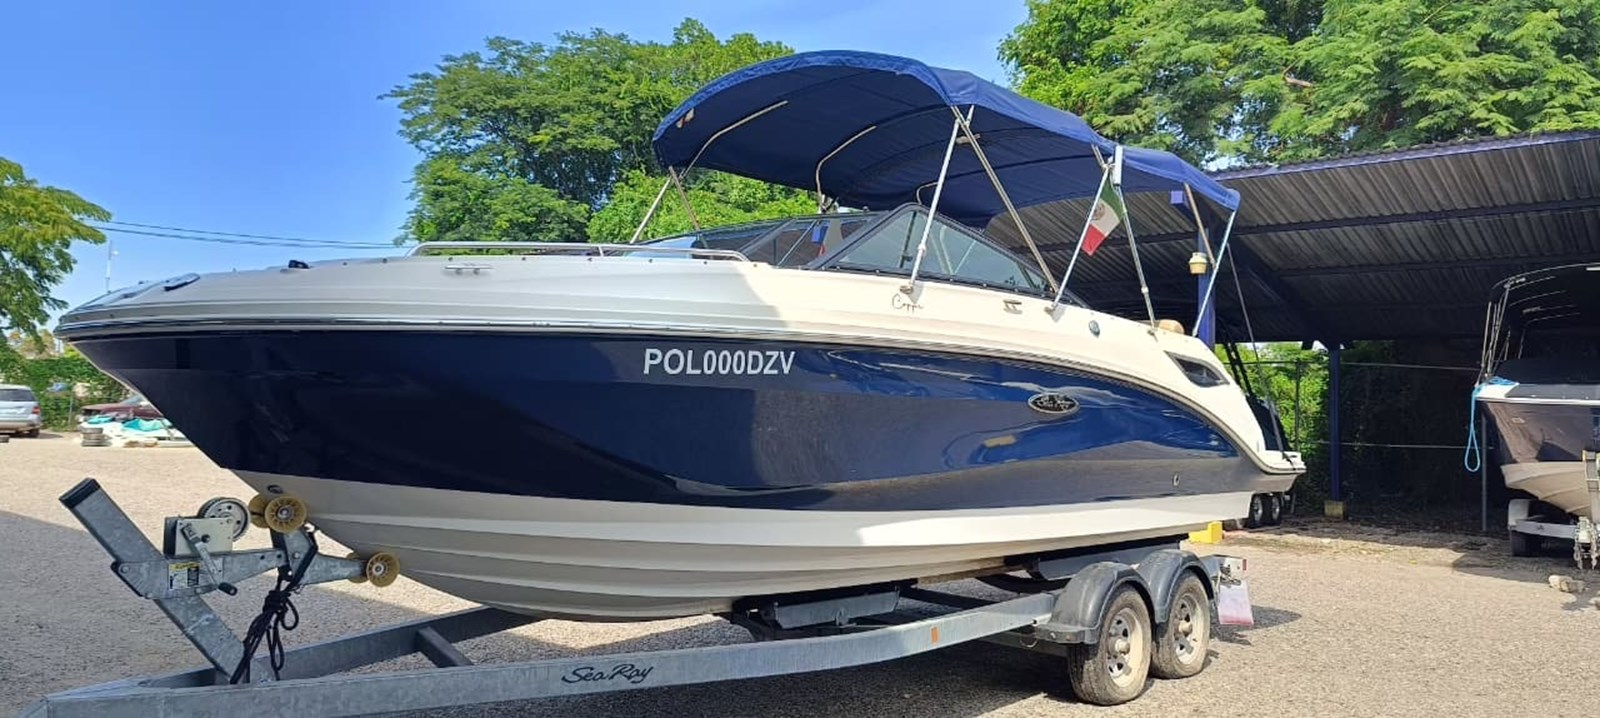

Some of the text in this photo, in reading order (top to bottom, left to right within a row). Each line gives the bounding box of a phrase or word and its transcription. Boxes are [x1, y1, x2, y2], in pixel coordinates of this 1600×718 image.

[643, 348, 796, 375] POL000DZV
[561, 663, 655, 684] Sea Ray
